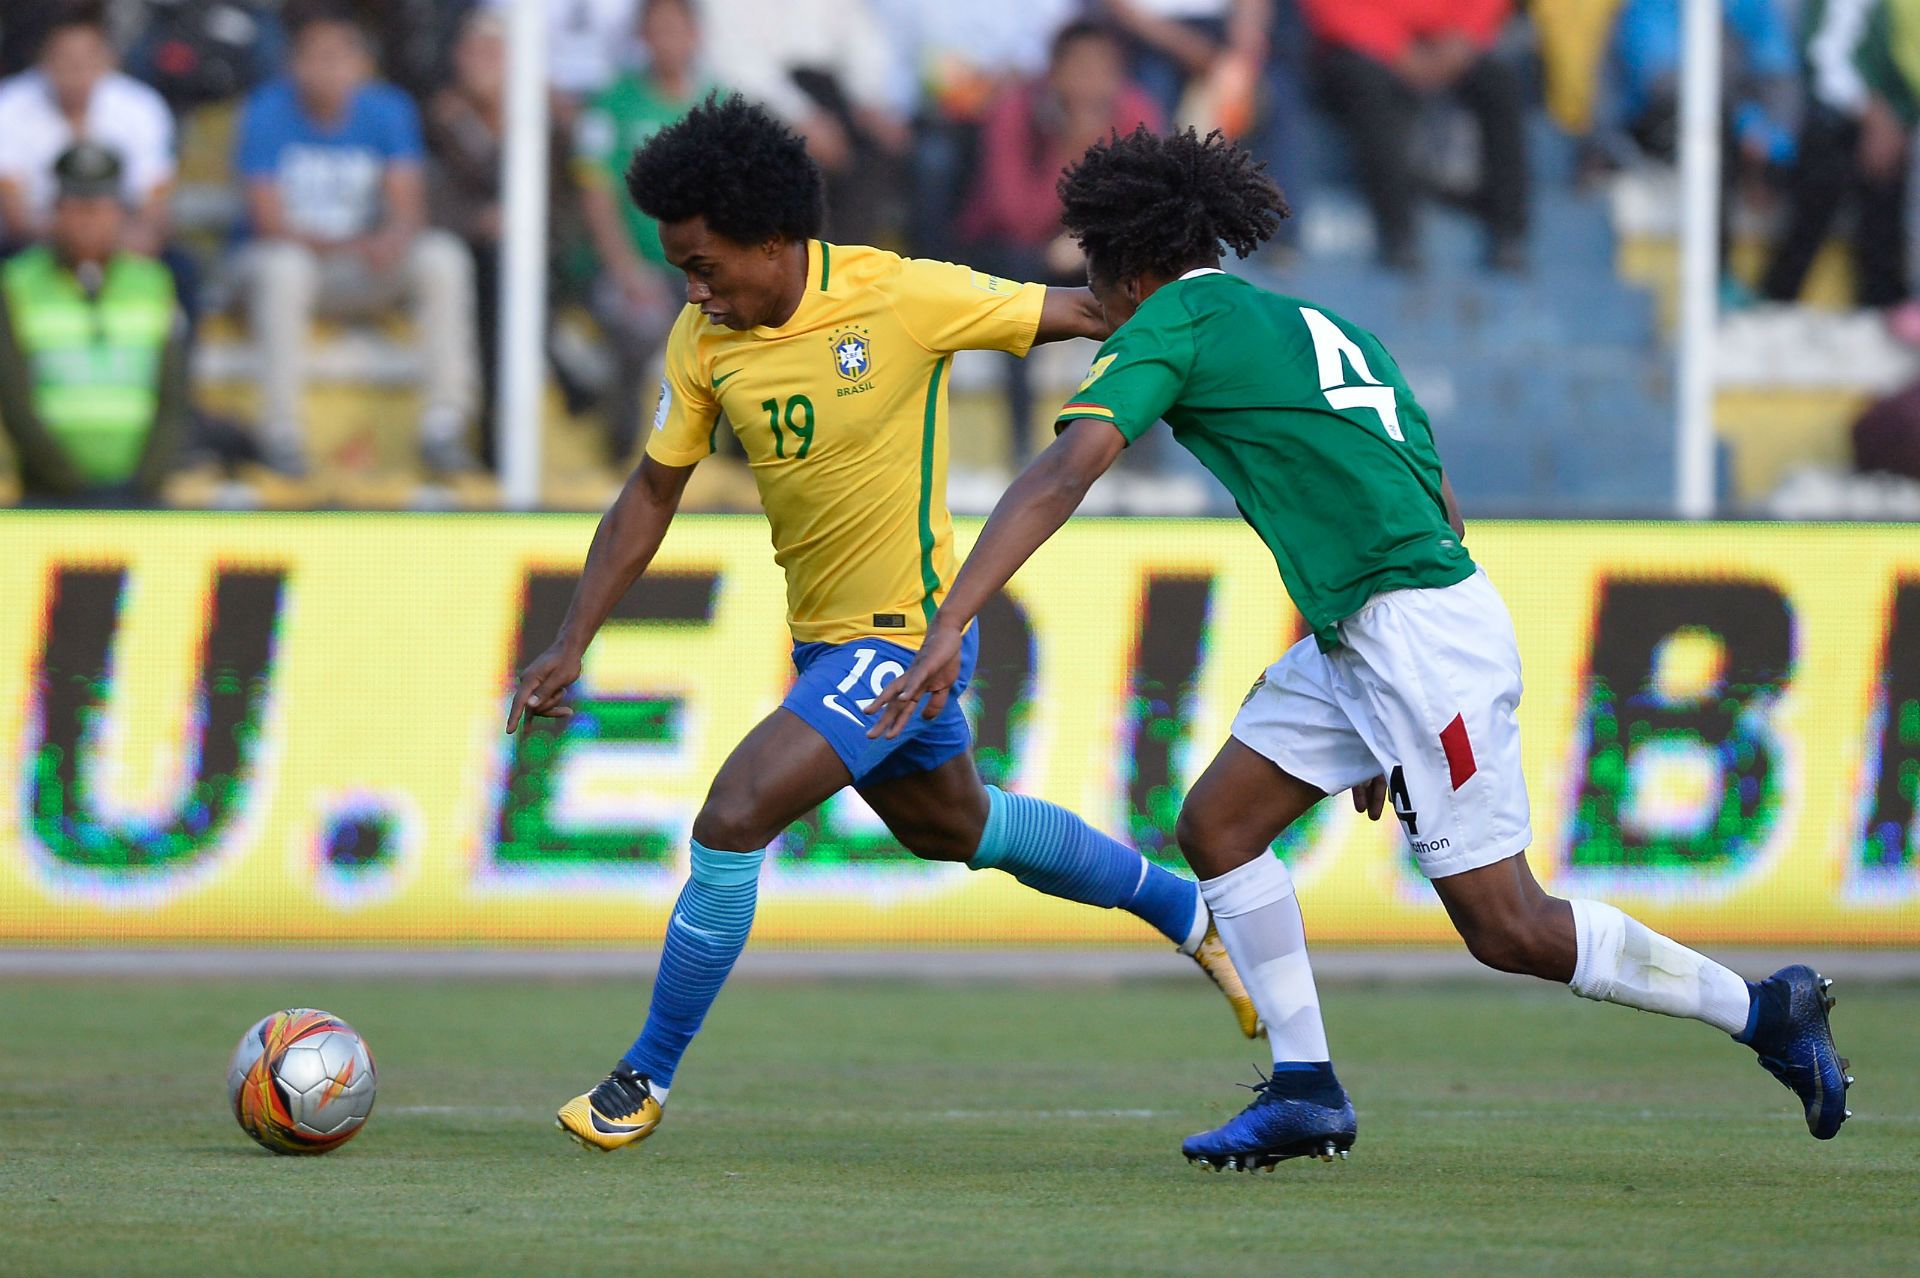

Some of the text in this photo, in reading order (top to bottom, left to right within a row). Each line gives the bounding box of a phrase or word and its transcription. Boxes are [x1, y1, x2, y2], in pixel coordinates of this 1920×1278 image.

[836, 381, 876, 398] BRASIL
[1298, 306, 1406, 442] 4
[761, 393, 815, 460] 19
[836, 648, 905, 711] 19
[1388, 765, 1419, 835] 4
